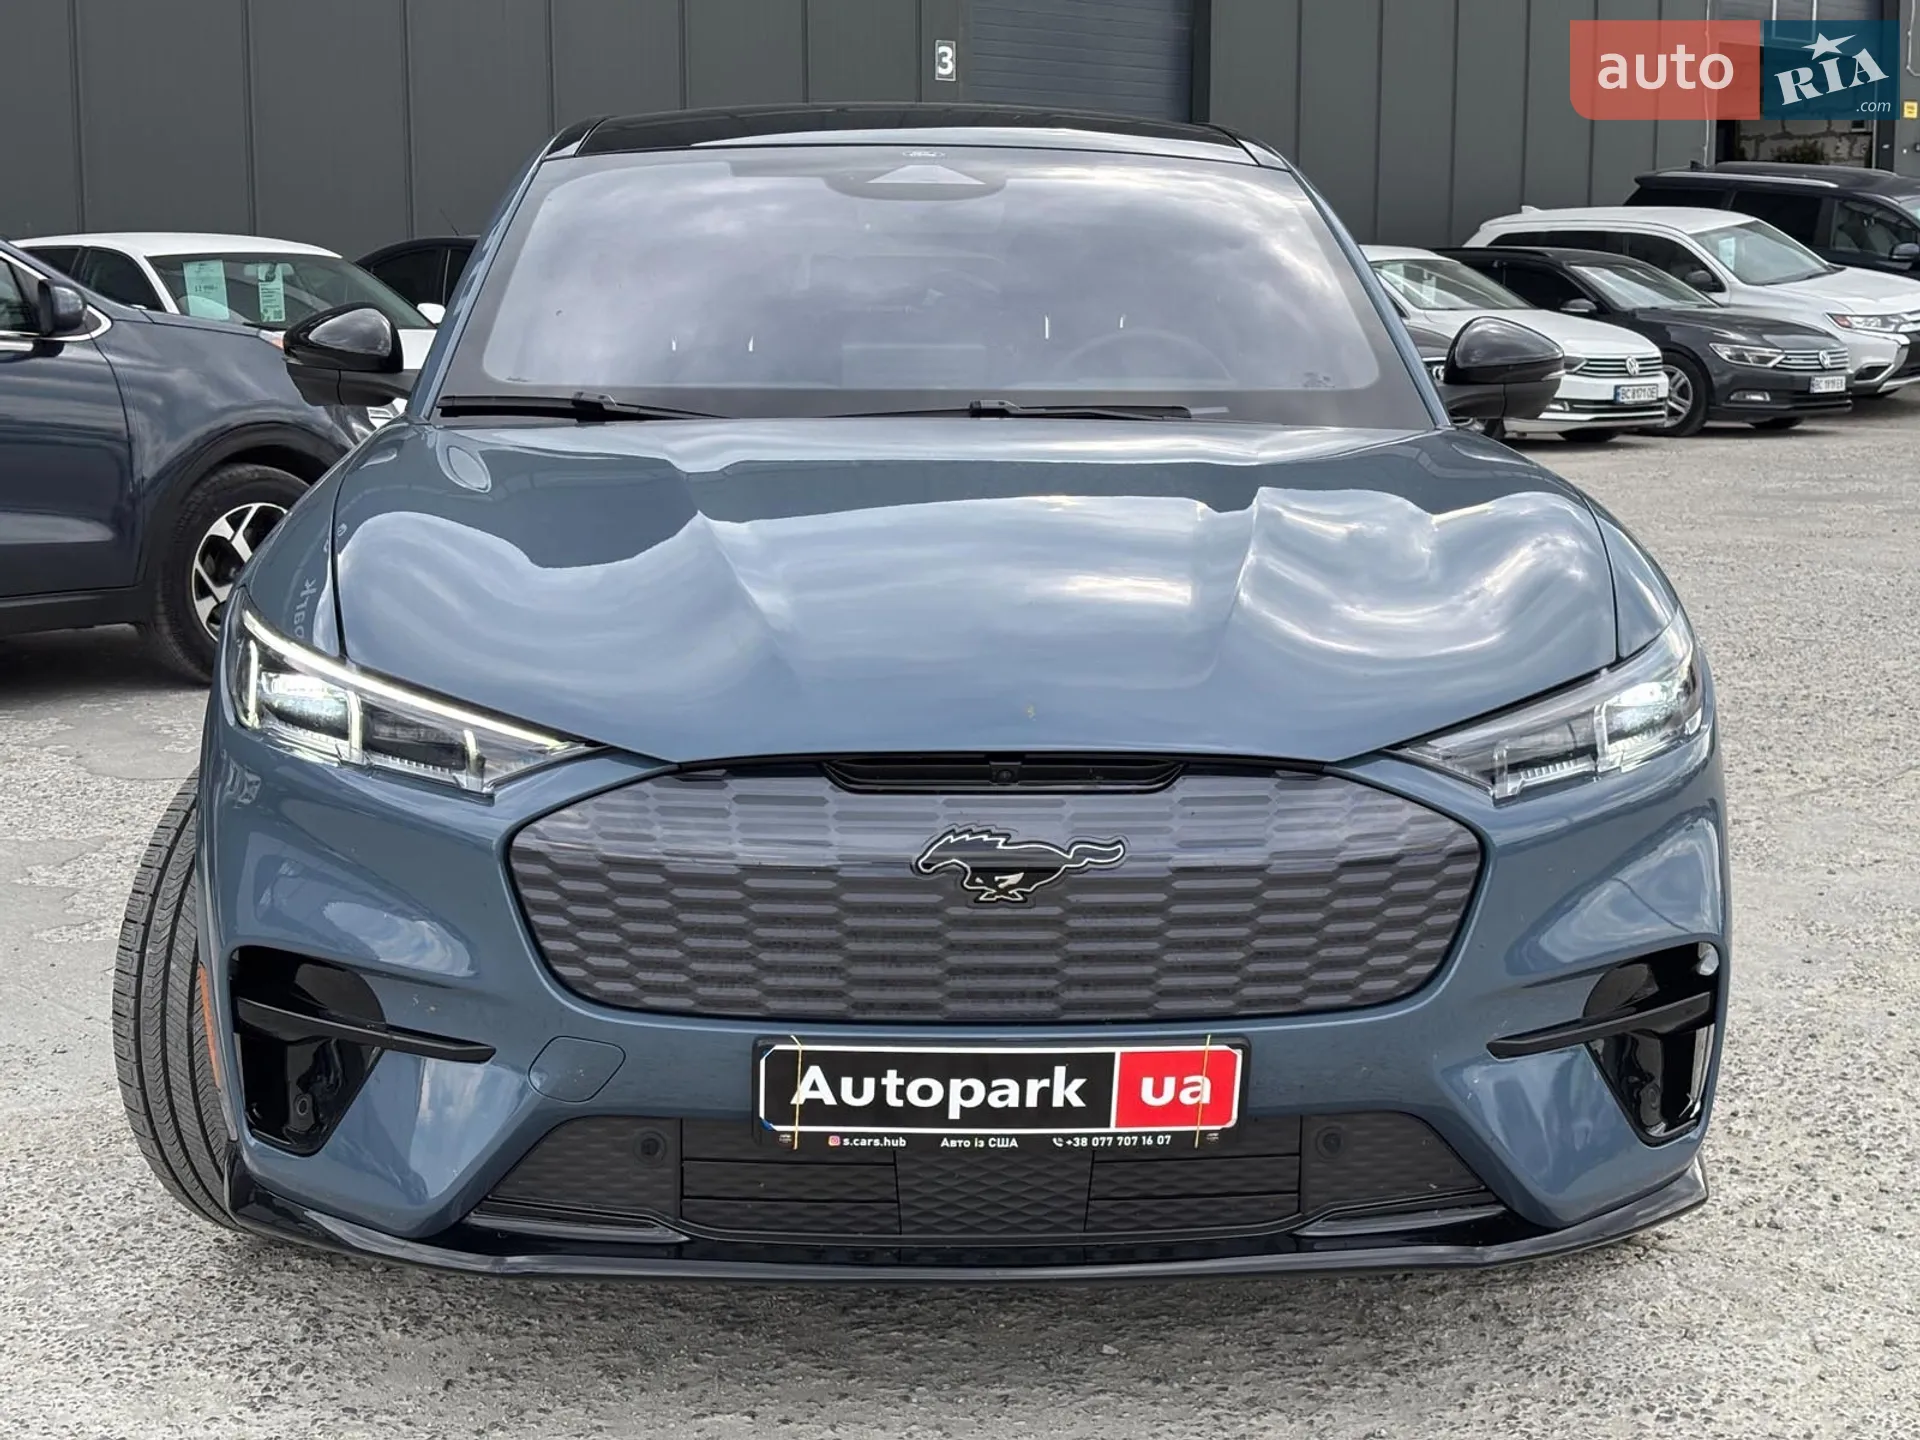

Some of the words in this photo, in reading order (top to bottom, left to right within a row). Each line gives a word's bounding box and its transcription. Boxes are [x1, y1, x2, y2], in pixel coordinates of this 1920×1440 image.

[938, 45, 953, 75] 3
[790, 1065, 1087, 1120] Autopark
[1140, 1075, 1212, 1106] ua
[842, 1136, 907, 1147] s.cars.hub
[940, 1137, 971, 1148] Авто
[988, 1137, 1019, 1148] США
[1065, 1136, 1088, 1148] +38
[1091, 1136, 1114, 1147] 077
[1116, 1135, 1138, 1147] 707
[1141, 1135, 1154, 1146] 16
[1156, 1134, 1172, 1145] 07
